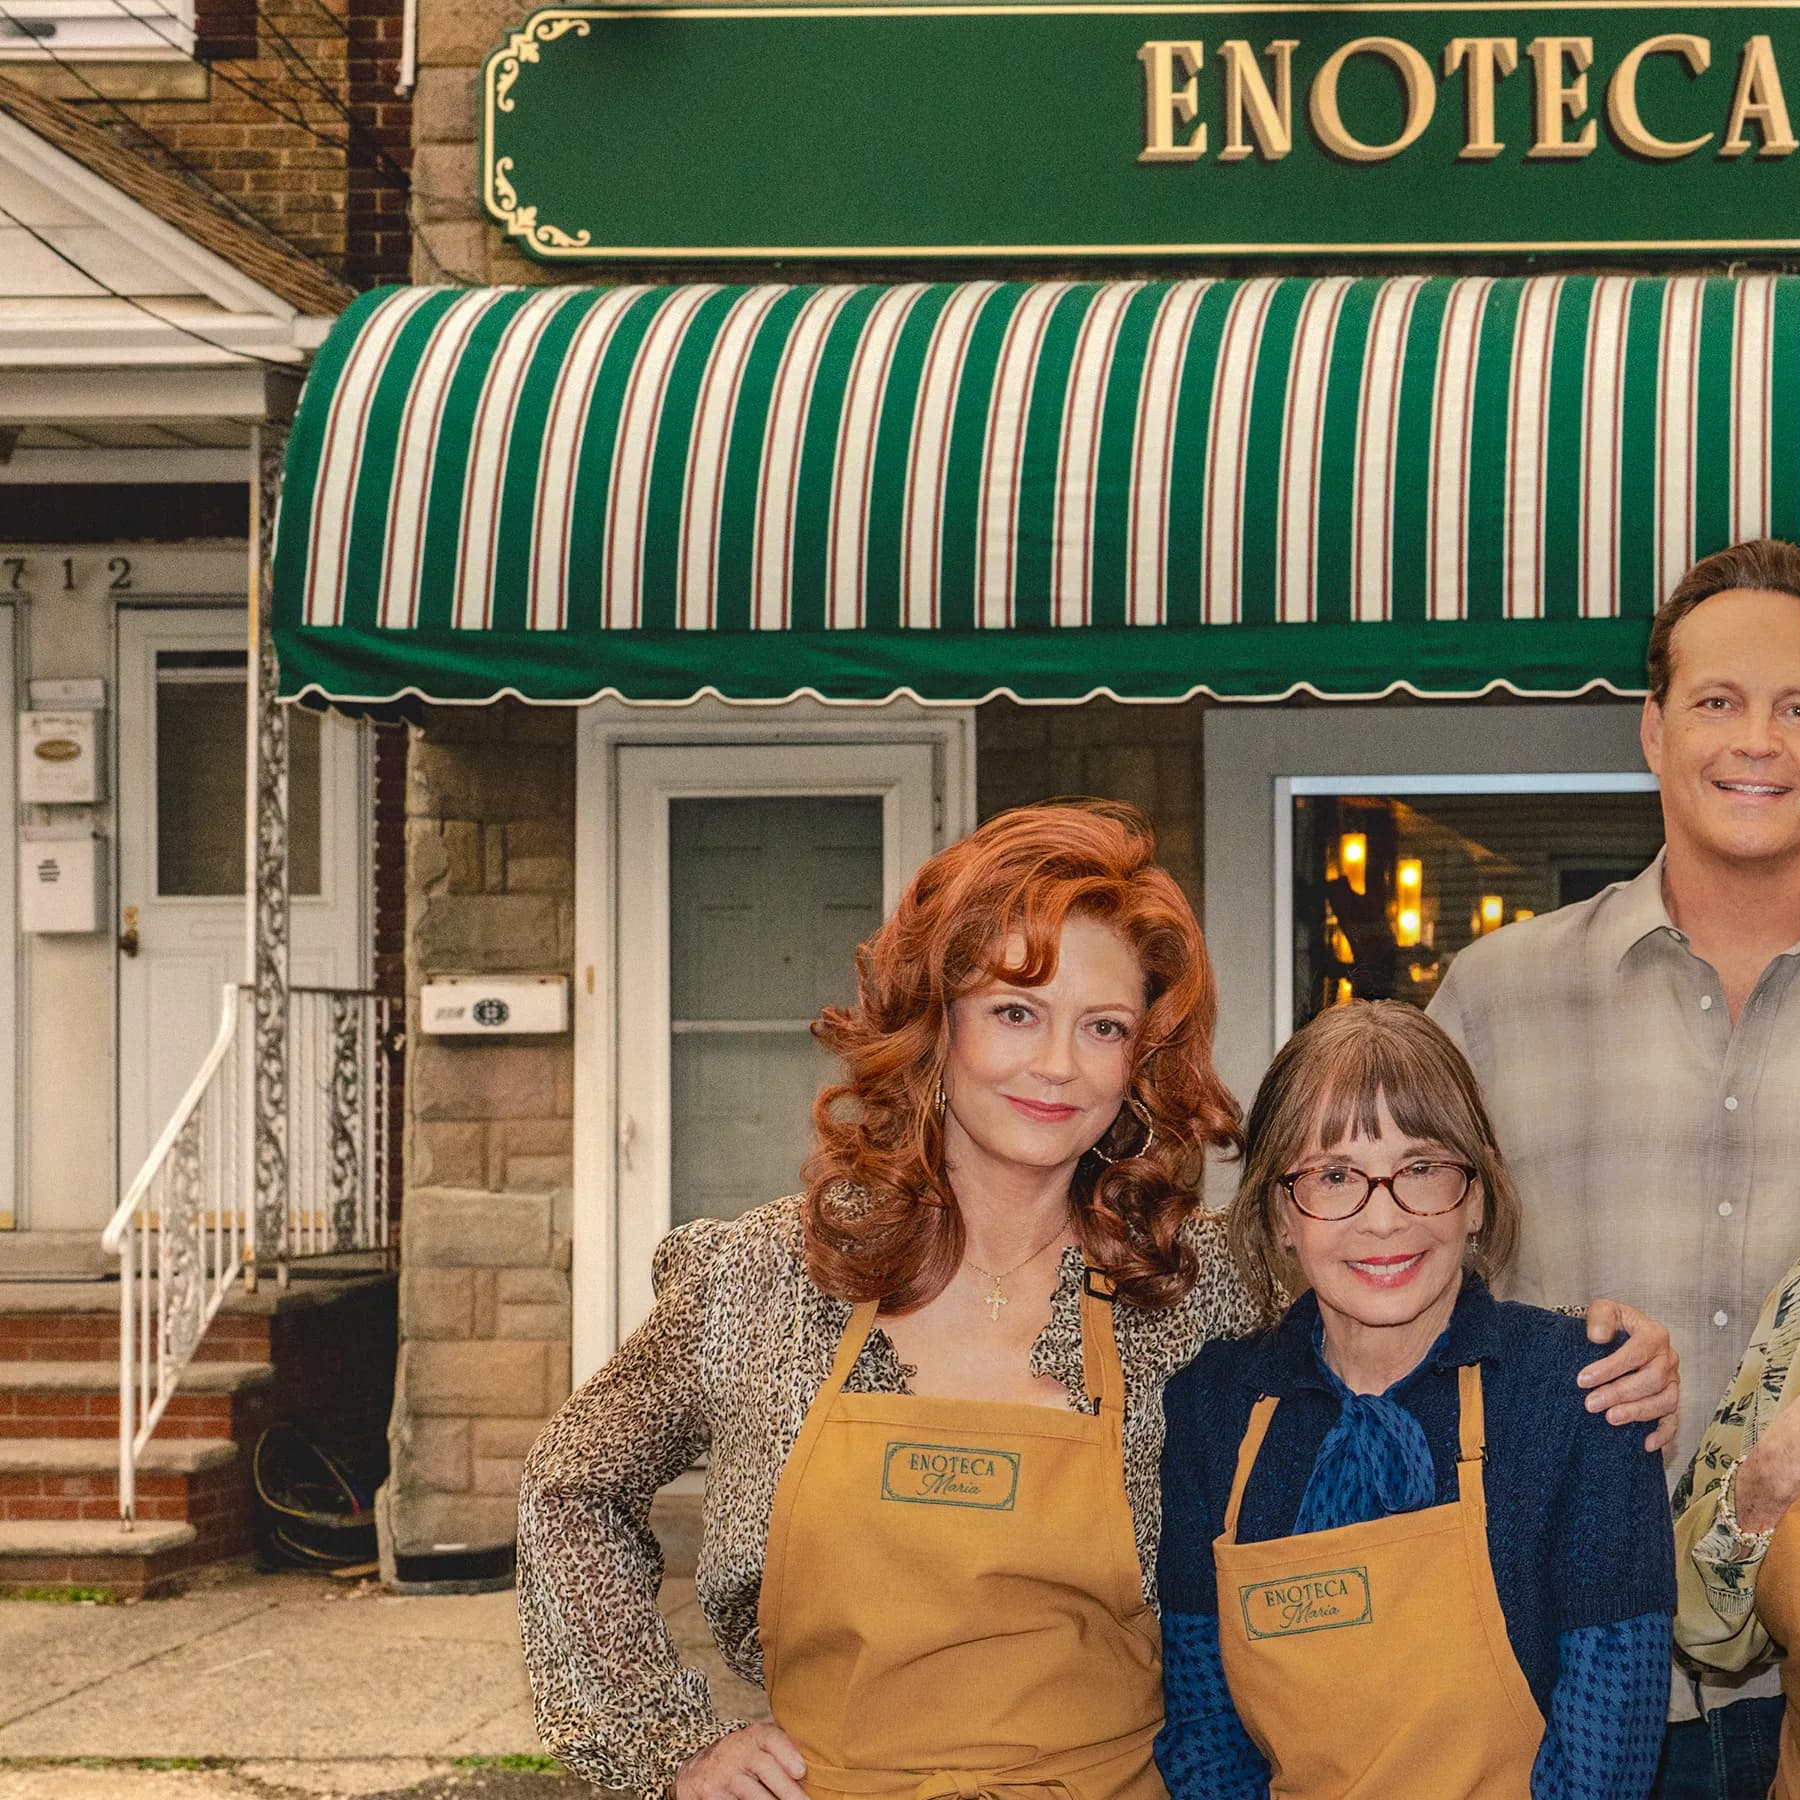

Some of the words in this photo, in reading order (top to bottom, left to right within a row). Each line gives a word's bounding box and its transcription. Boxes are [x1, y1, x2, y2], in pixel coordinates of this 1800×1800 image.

[1137, 33, 1799, 163] ENOTECA
[910, 1453, 995, 1476] ENOTECA
[915, 1472, 981, 1496] Maria
[1263, 1578, 1349, 1607] ENOTECA
[1279, 1601, 1341, 1629] Maria
